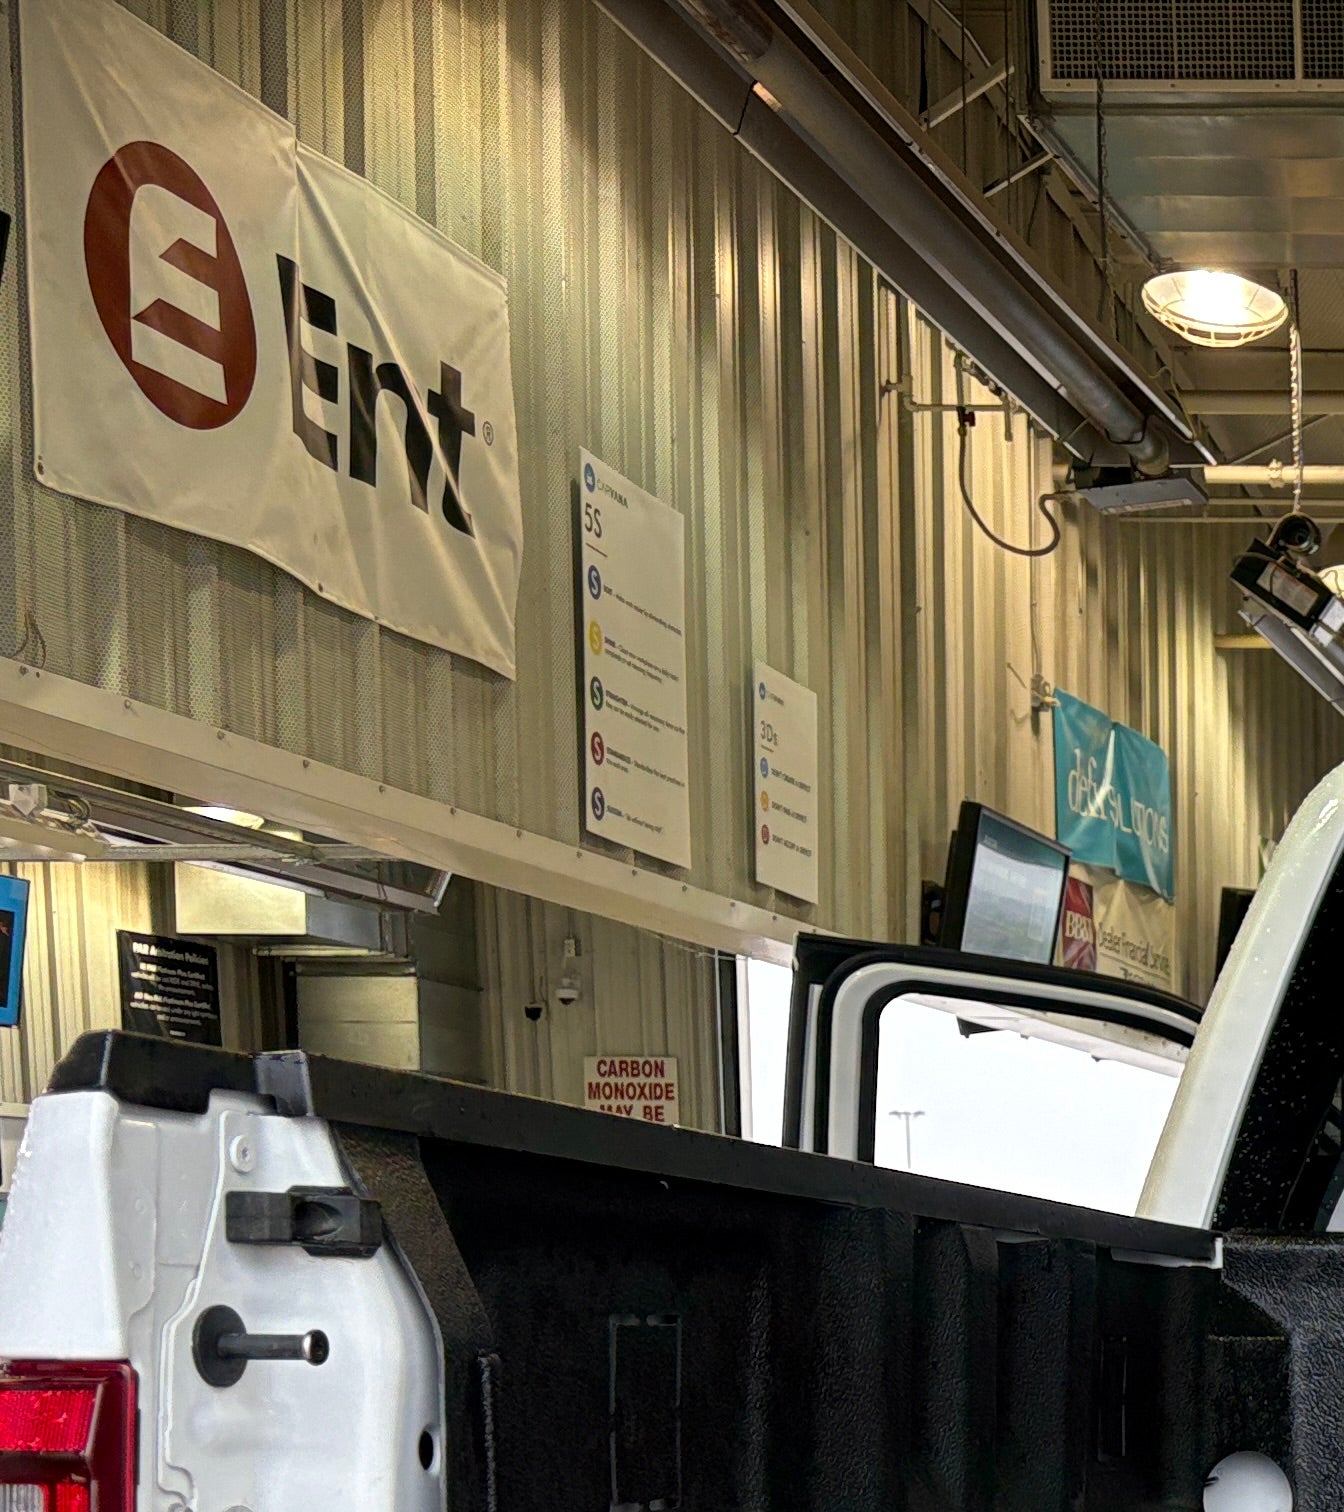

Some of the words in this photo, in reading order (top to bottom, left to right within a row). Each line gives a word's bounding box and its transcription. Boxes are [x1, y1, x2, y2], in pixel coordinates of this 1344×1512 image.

[276, 253, 475, 539] Ent
[585, 502, 602, 539] 5S
[596, 1059, 665, 1078] CARBON
[587, 1082, 676, 1101] MONOXIDE
[643, 1105, 665, 1122] BE
